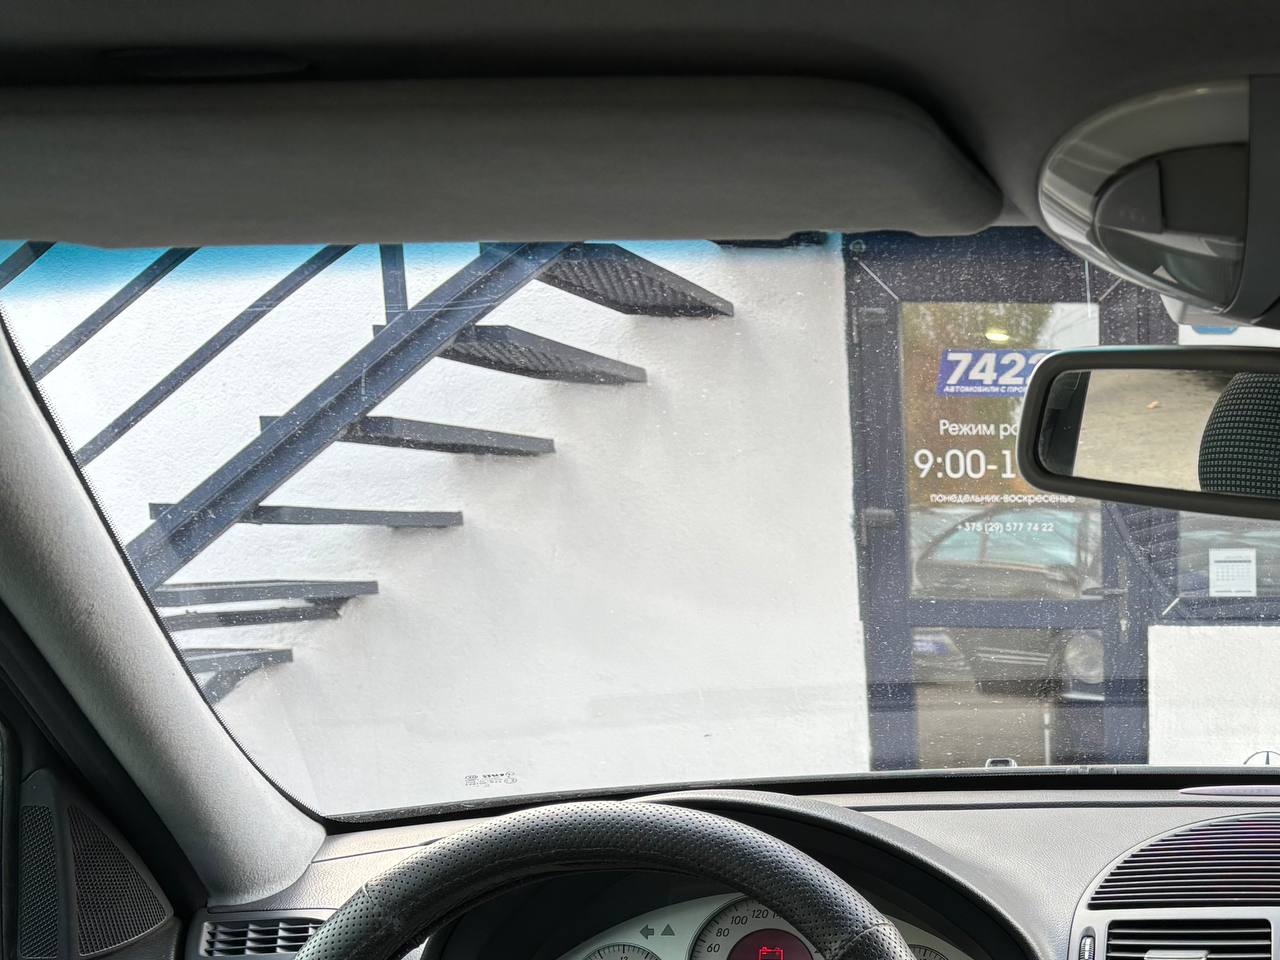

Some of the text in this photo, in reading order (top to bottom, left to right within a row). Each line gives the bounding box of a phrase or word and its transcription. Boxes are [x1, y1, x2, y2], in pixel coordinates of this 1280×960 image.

[939, 419, 995, 436] Режим
[914, 449, 1016, 479] 9:00-1
[985, 522, 1003, 533] (29)
[1006, 522, 1024, 532] 577
[1027, 522, 1039, 532] 74
[1041, 522, 1054, 532] 22
[752, 910, 768, 918] 120
[731, 916, 748, 925] 100
[716, 928, 729, 937] 80
[707, 944, 720, 952] 60
